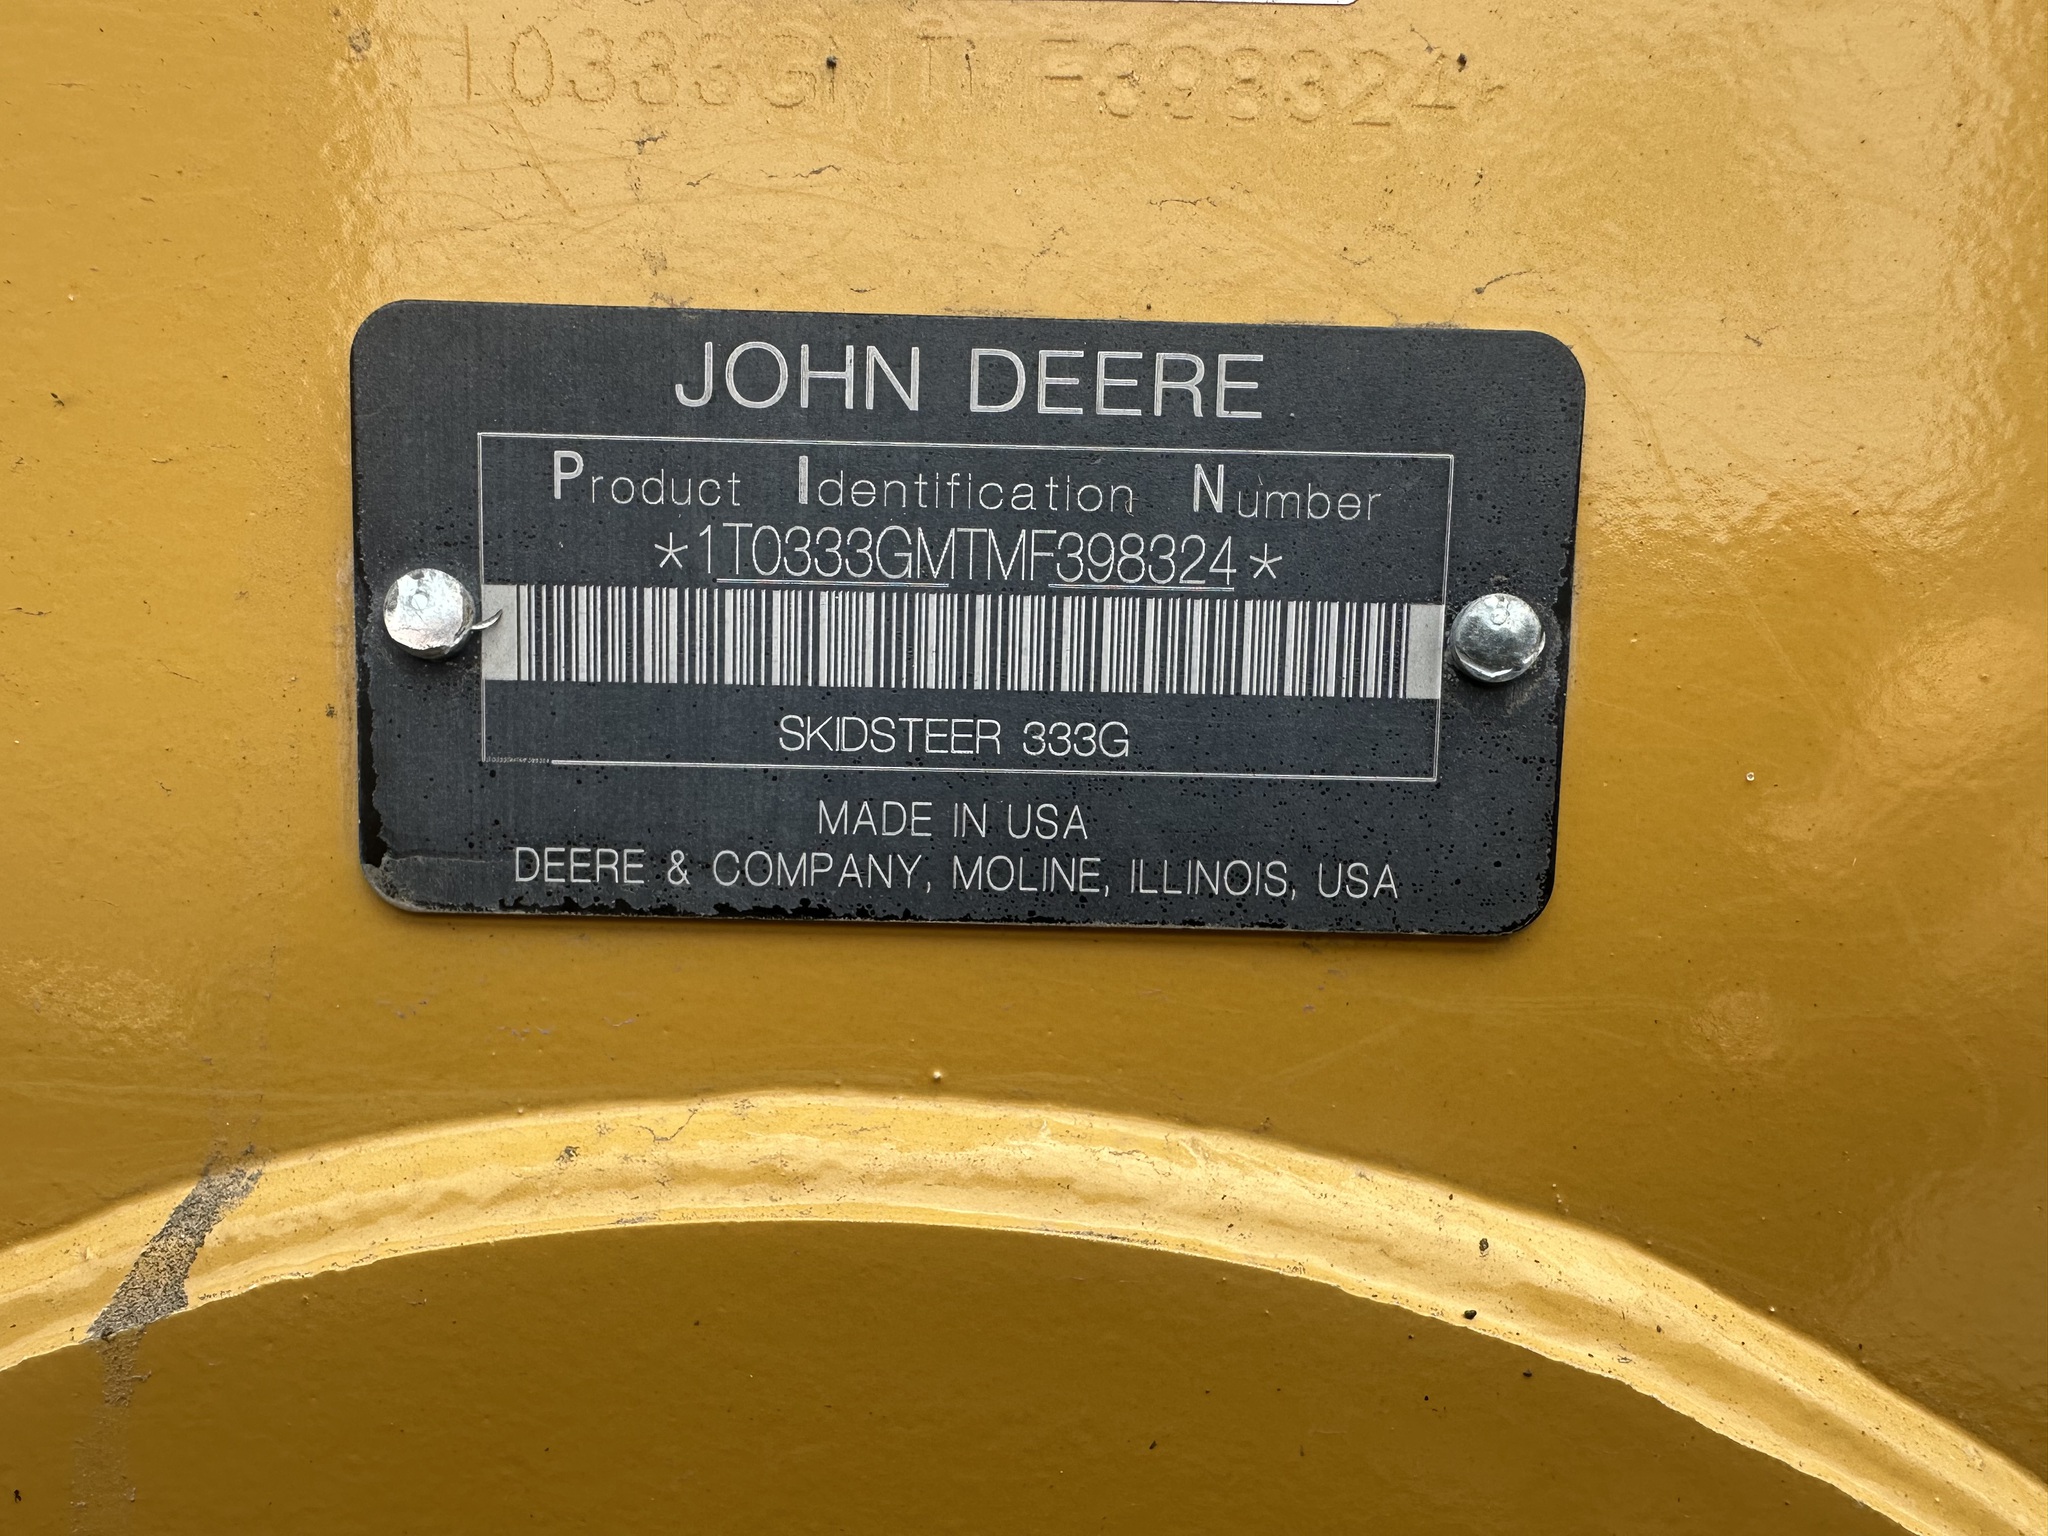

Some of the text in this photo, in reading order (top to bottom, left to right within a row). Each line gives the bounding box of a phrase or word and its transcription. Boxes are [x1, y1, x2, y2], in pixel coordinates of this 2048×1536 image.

[675, 341, 1265, 420] JOHN DEERE
[553, 450, 1382, 521] Product Identification Number
[779, 714, 1130, 758] SKIDSTEER 333G
[818, 800, 1089, 841] MADE IN USA
[514, 846, 1399, 901] DEERE & COMPANY, MOLINE, ILLINOIS, USA
